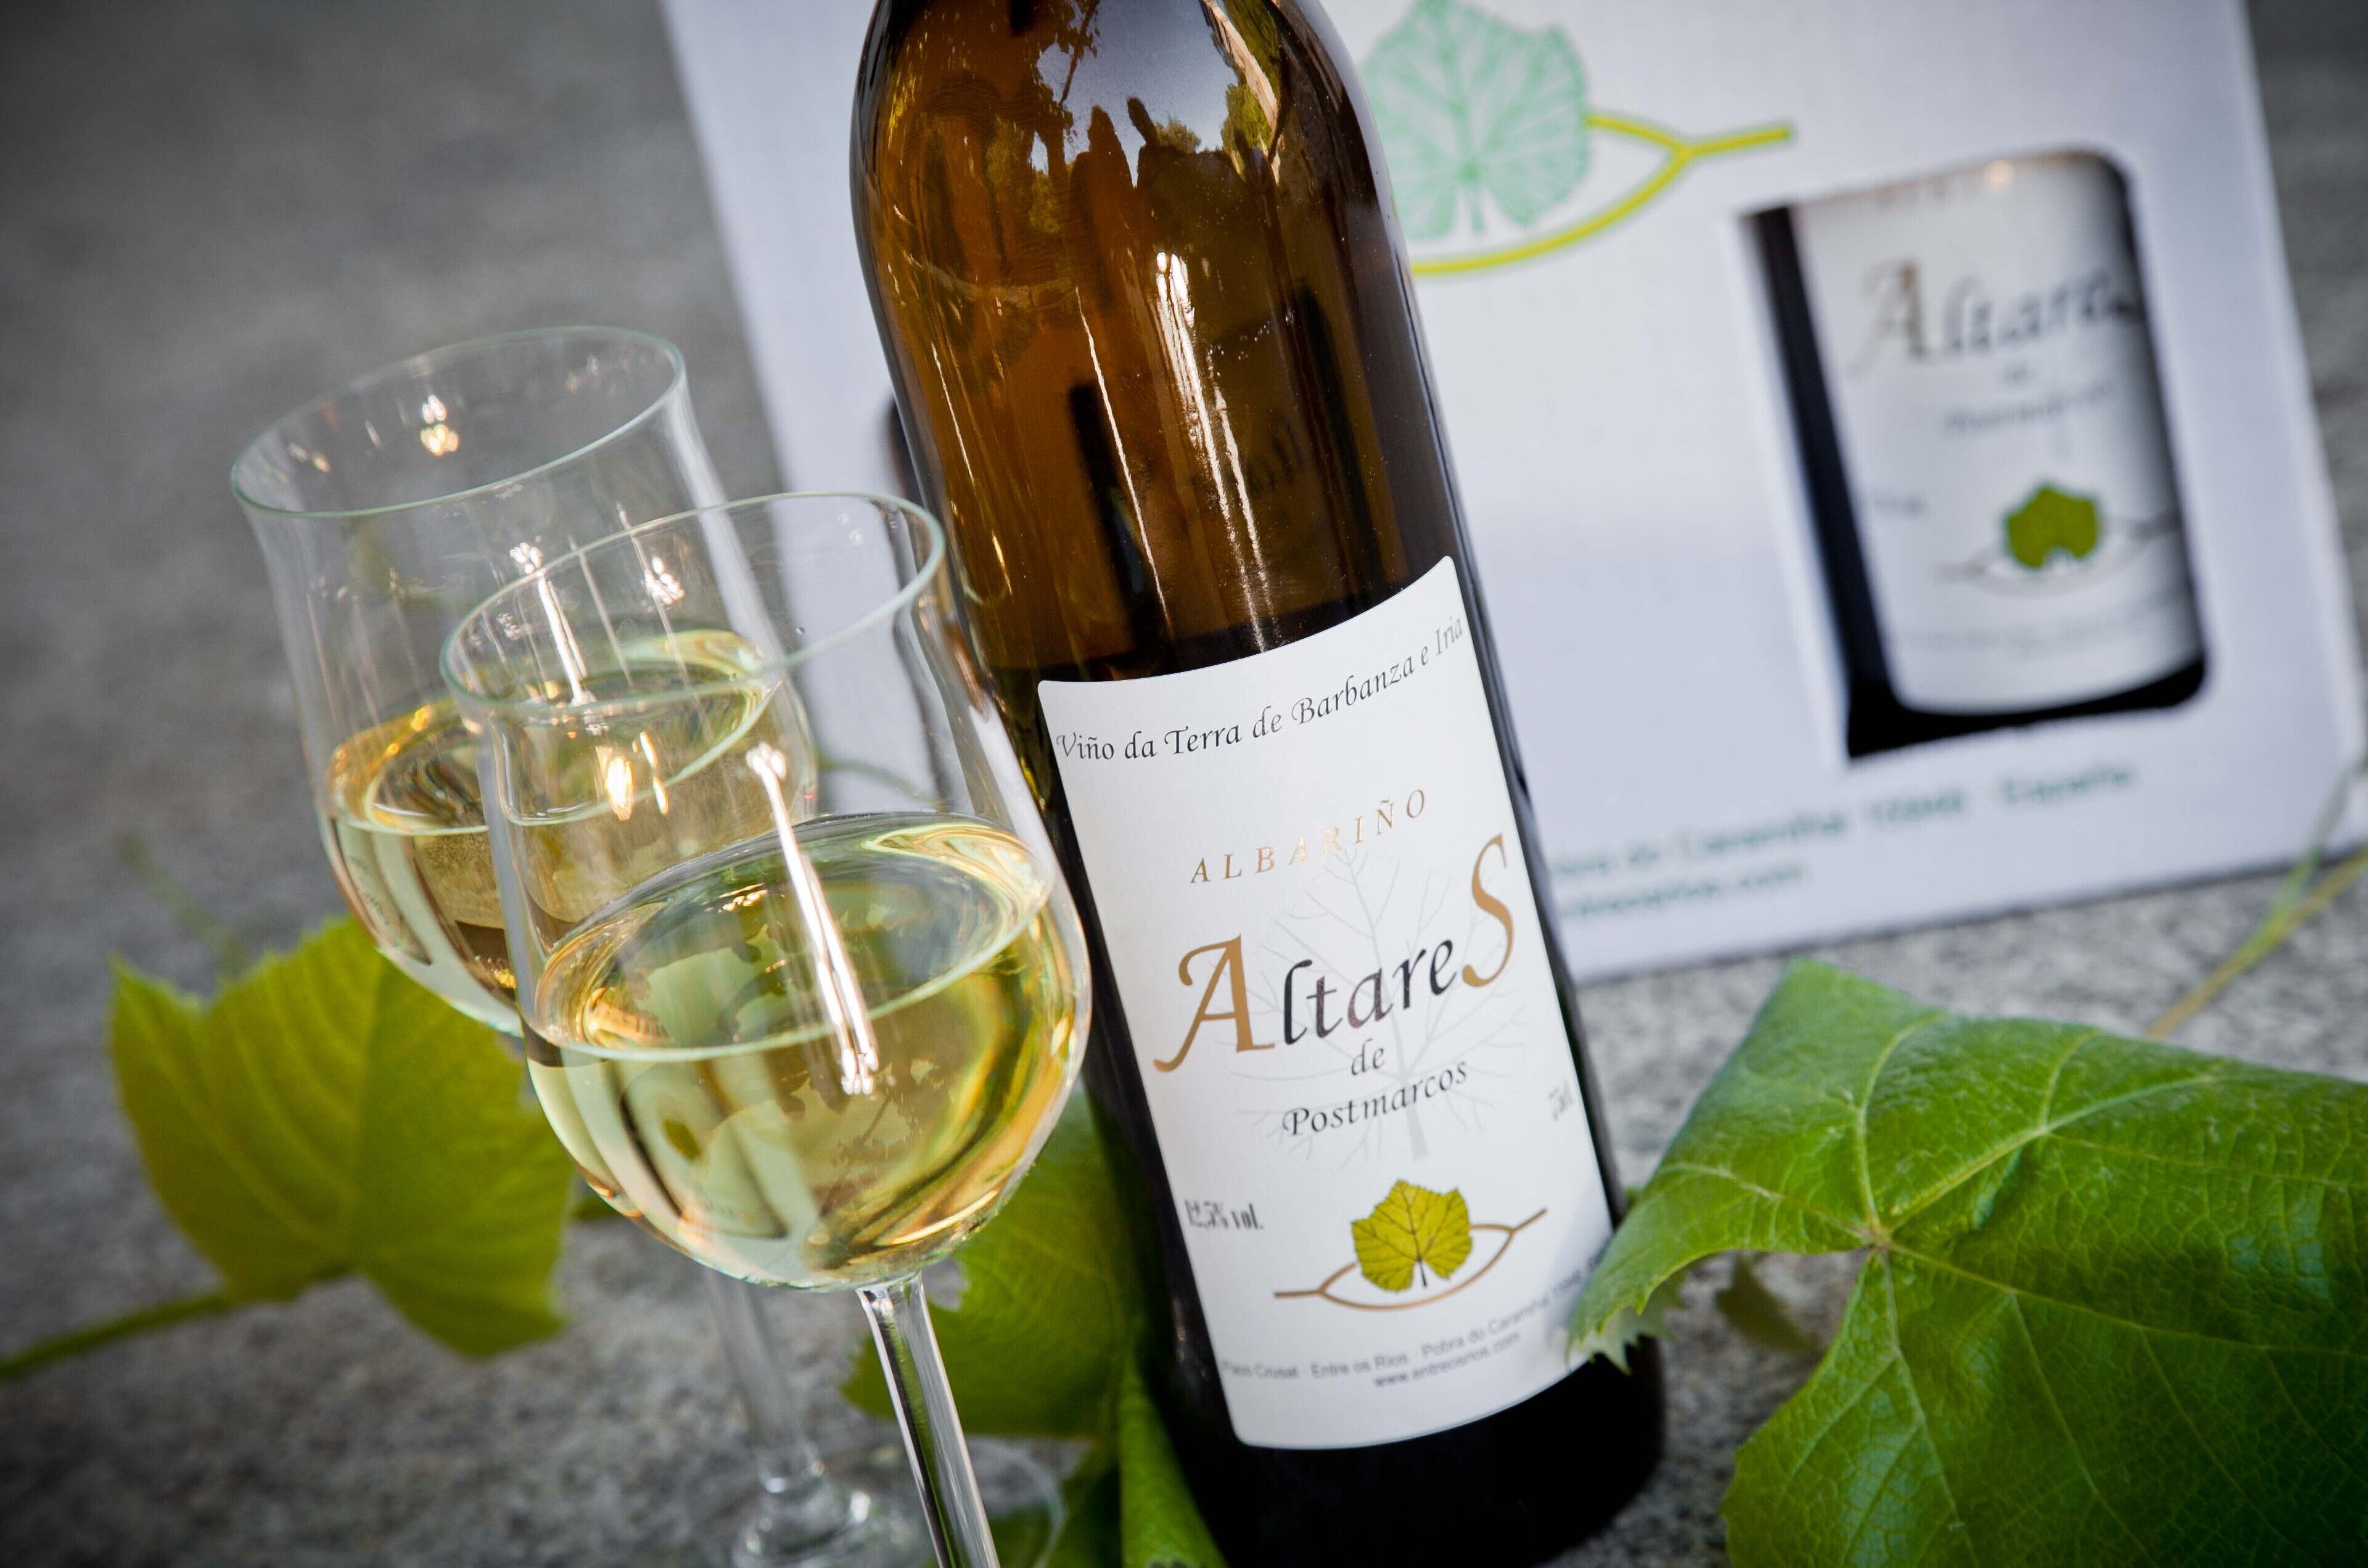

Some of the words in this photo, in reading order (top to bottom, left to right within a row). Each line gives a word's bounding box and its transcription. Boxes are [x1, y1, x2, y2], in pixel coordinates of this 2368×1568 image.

[1056, 733, 1114, 760] Viño
[1124, 731, 1157, 759] da
[1164, 725, 1242, 755] Terra
[1252, 705, 1283, 739] de
[1291, 654, 1415, 726] Barbanza
[1420, 645, 1430, 666] e
[1435, 617, 1465, 655] Iria
[1190, 789, 1425, 884] ALBARIÑO
[1281, 1061, 1468, 1136] Postmarcos
[1350, 1038, 1386, 1076] de
